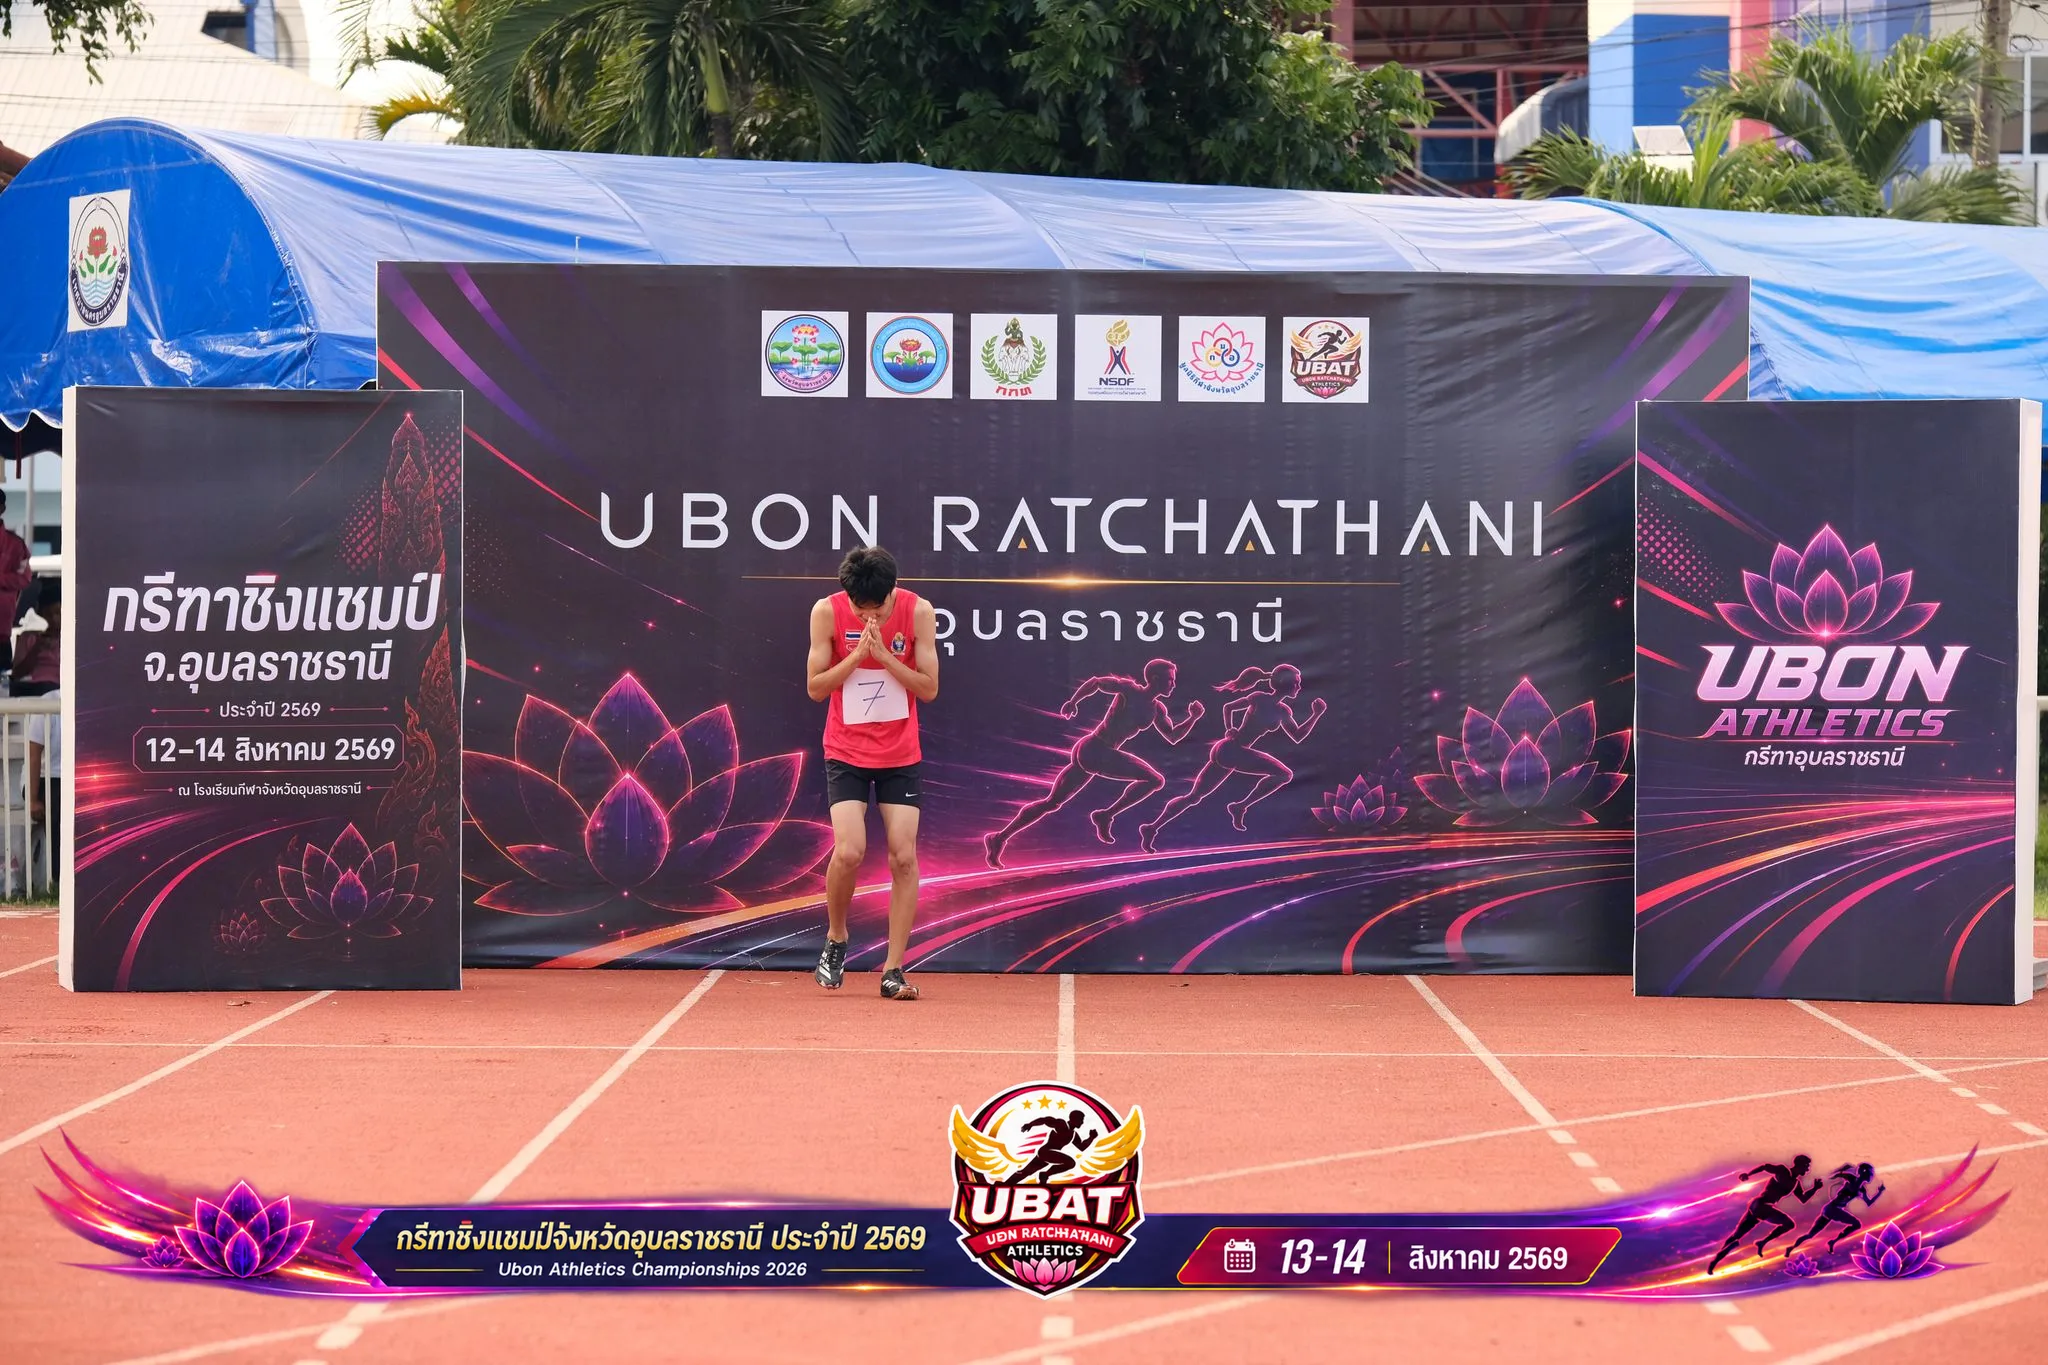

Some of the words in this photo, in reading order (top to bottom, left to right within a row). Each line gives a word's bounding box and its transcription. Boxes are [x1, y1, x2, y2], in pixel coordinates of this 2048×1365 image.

[1099, 377, 1135, 386] NSDF
[1296, 360, 1356, 376] UBAT
[995, 385, 1033, 397] กกท
[600, 491, 879, 550] UBON
[933, 495, 1543, 556] RATCHATHANI
[103, 571, 443, 633] กรีฑาชิงแชมป์
[934, 597, 1283, 656] อุบลราชธานี
[144, 639, 393, 694] จ.อุบลราชธานี
[1696, 644, 1971, 702] UBON
[219, 701, 276, 718] ประจำปี
[281, 702, 321, 718] 2569
[857, 680, 886, 717] 7
[1704, 708, 1953, 738] ATHLETICS
[234, 736, 326, 762] สิงหาคม
[335, 737, 396, 761] 2569
[1744, 744, 1907, 772] กรีฑาอุบลราชธานี
[178, 785, 190, 796] ณ
[193, 781, 362, 799] โรงเรียนกีฬาจังหวัดอุบลราชธานี
